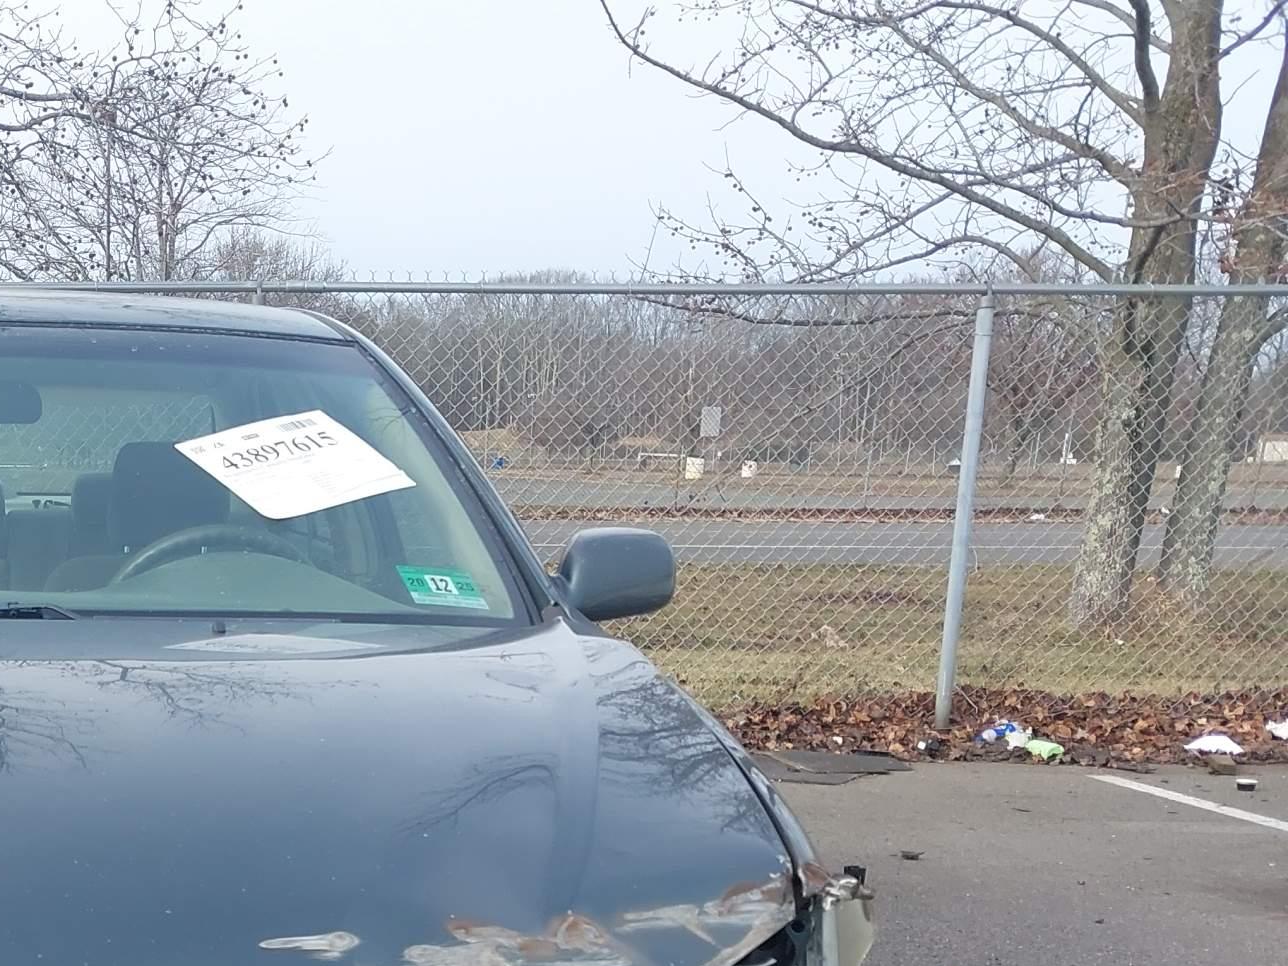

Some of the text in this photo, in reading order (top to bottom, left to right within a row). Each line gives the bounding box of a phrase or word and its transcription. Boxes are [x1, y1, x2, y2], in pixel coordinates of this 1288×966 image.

[221, 431, 338, 470] 43897615
[407, 577, 424, 588] 20
[430, 577, 452, 593] 12
